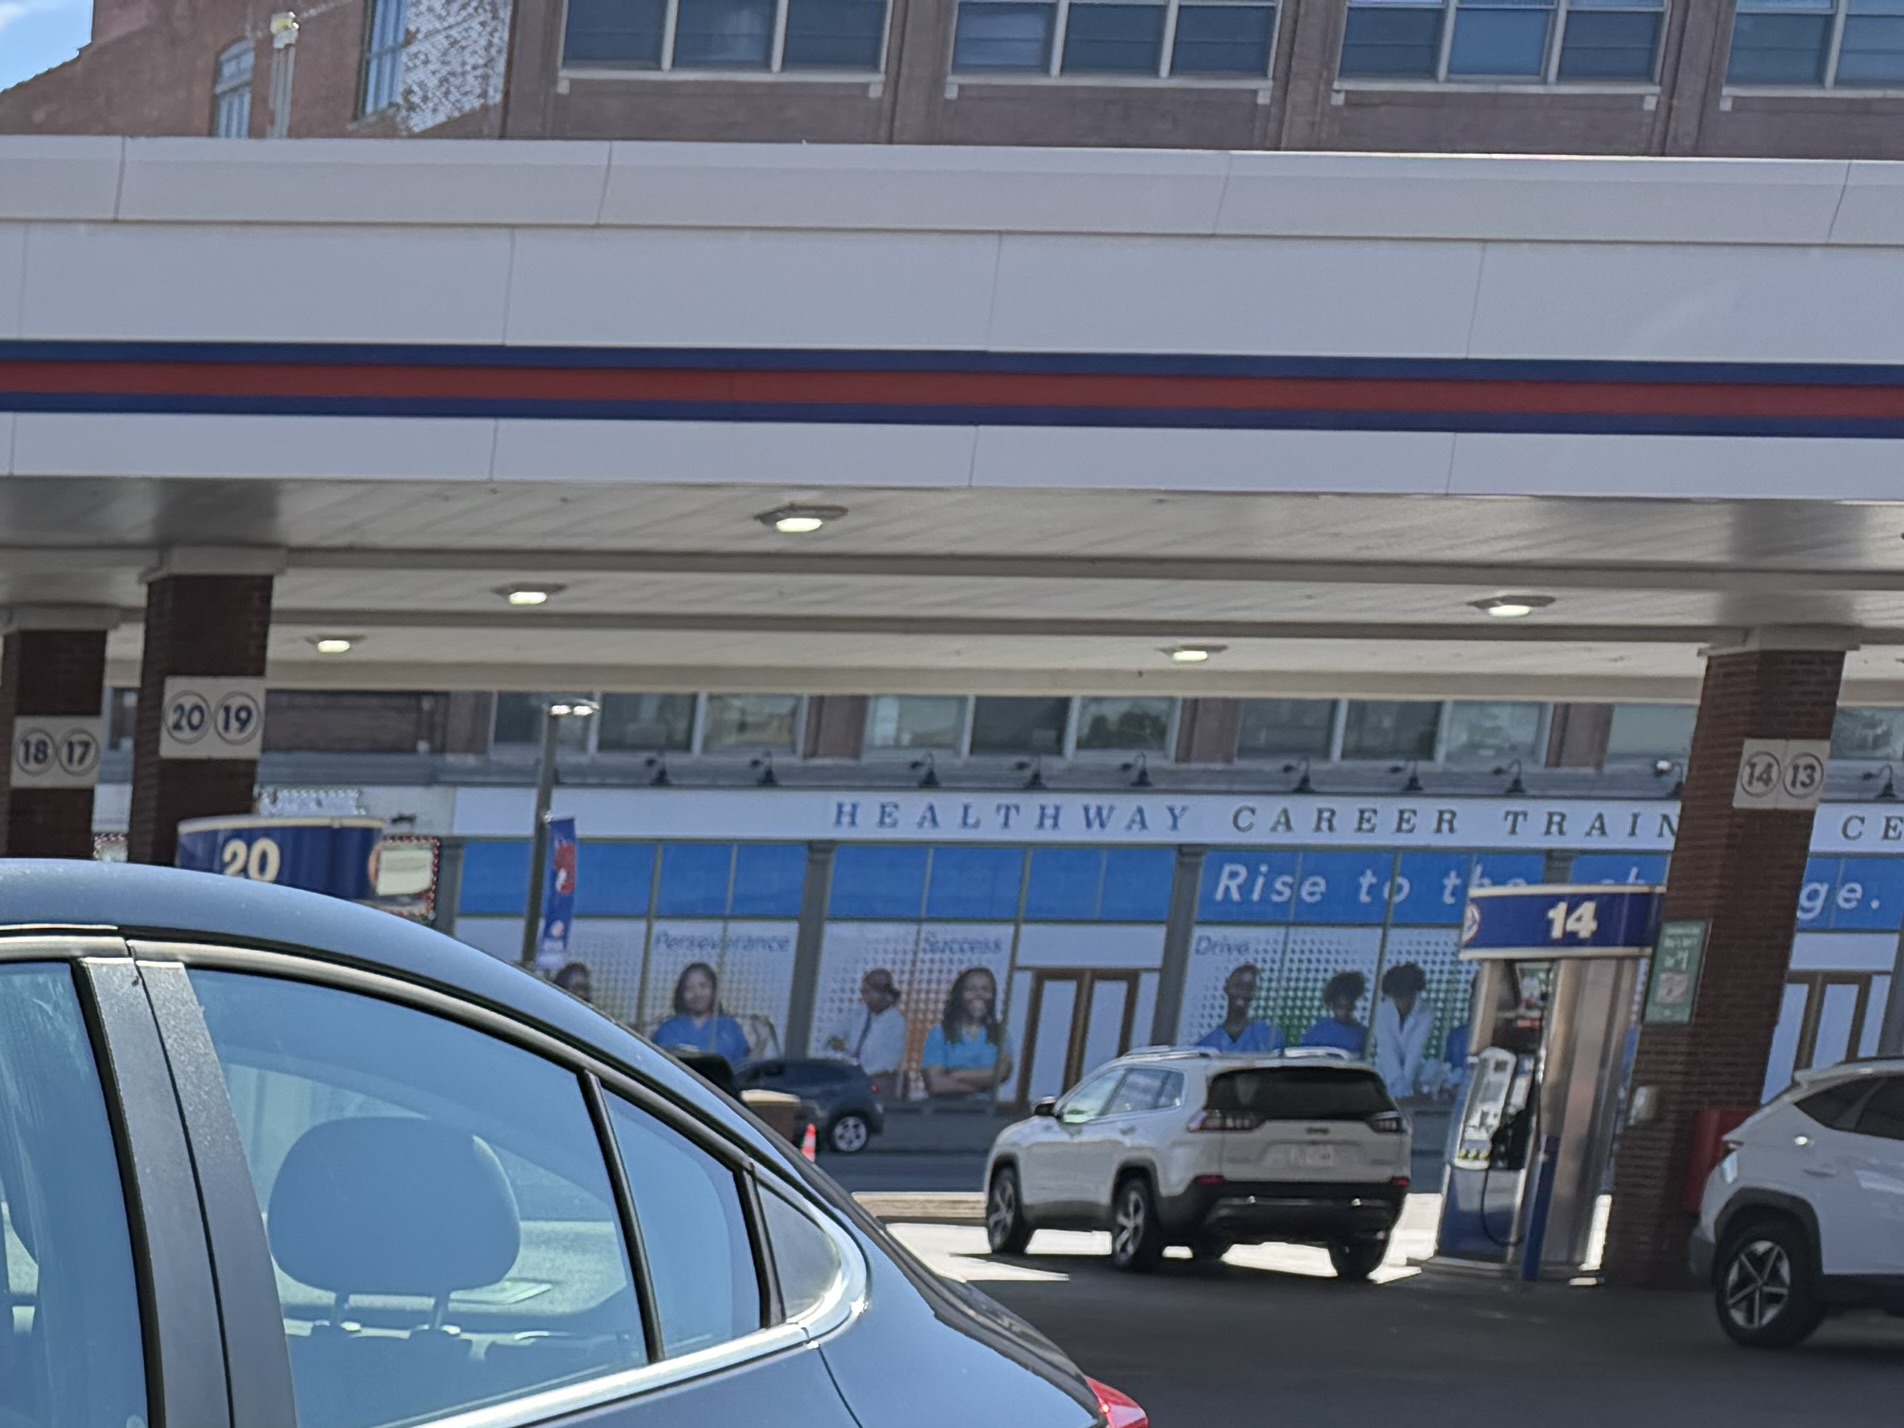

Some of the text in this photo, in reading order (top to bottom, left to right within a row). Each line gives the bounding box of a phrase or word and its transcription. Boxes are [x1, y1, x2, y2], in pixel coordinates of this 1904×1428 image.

[171, 703, 253, 732] 20 19
[22, 739, 91, 766] 18 17
[1746, 762, 1817, 789] 14 13
[833, 800, 1190, 833] HEALTHWAY
[1232, 805, 1459, 835] CAREER
[221, 836, 281, 883] 20
[1214, 863, 1327, 904] Rise
[1358, 868, 1411, 904] to
[1547, 900, 1597, 939] 14
[654, 929, 791, 952] Perseverance
[923, 931, 1002, 953] Success
[1195, 935, 1250, 956] Drive
